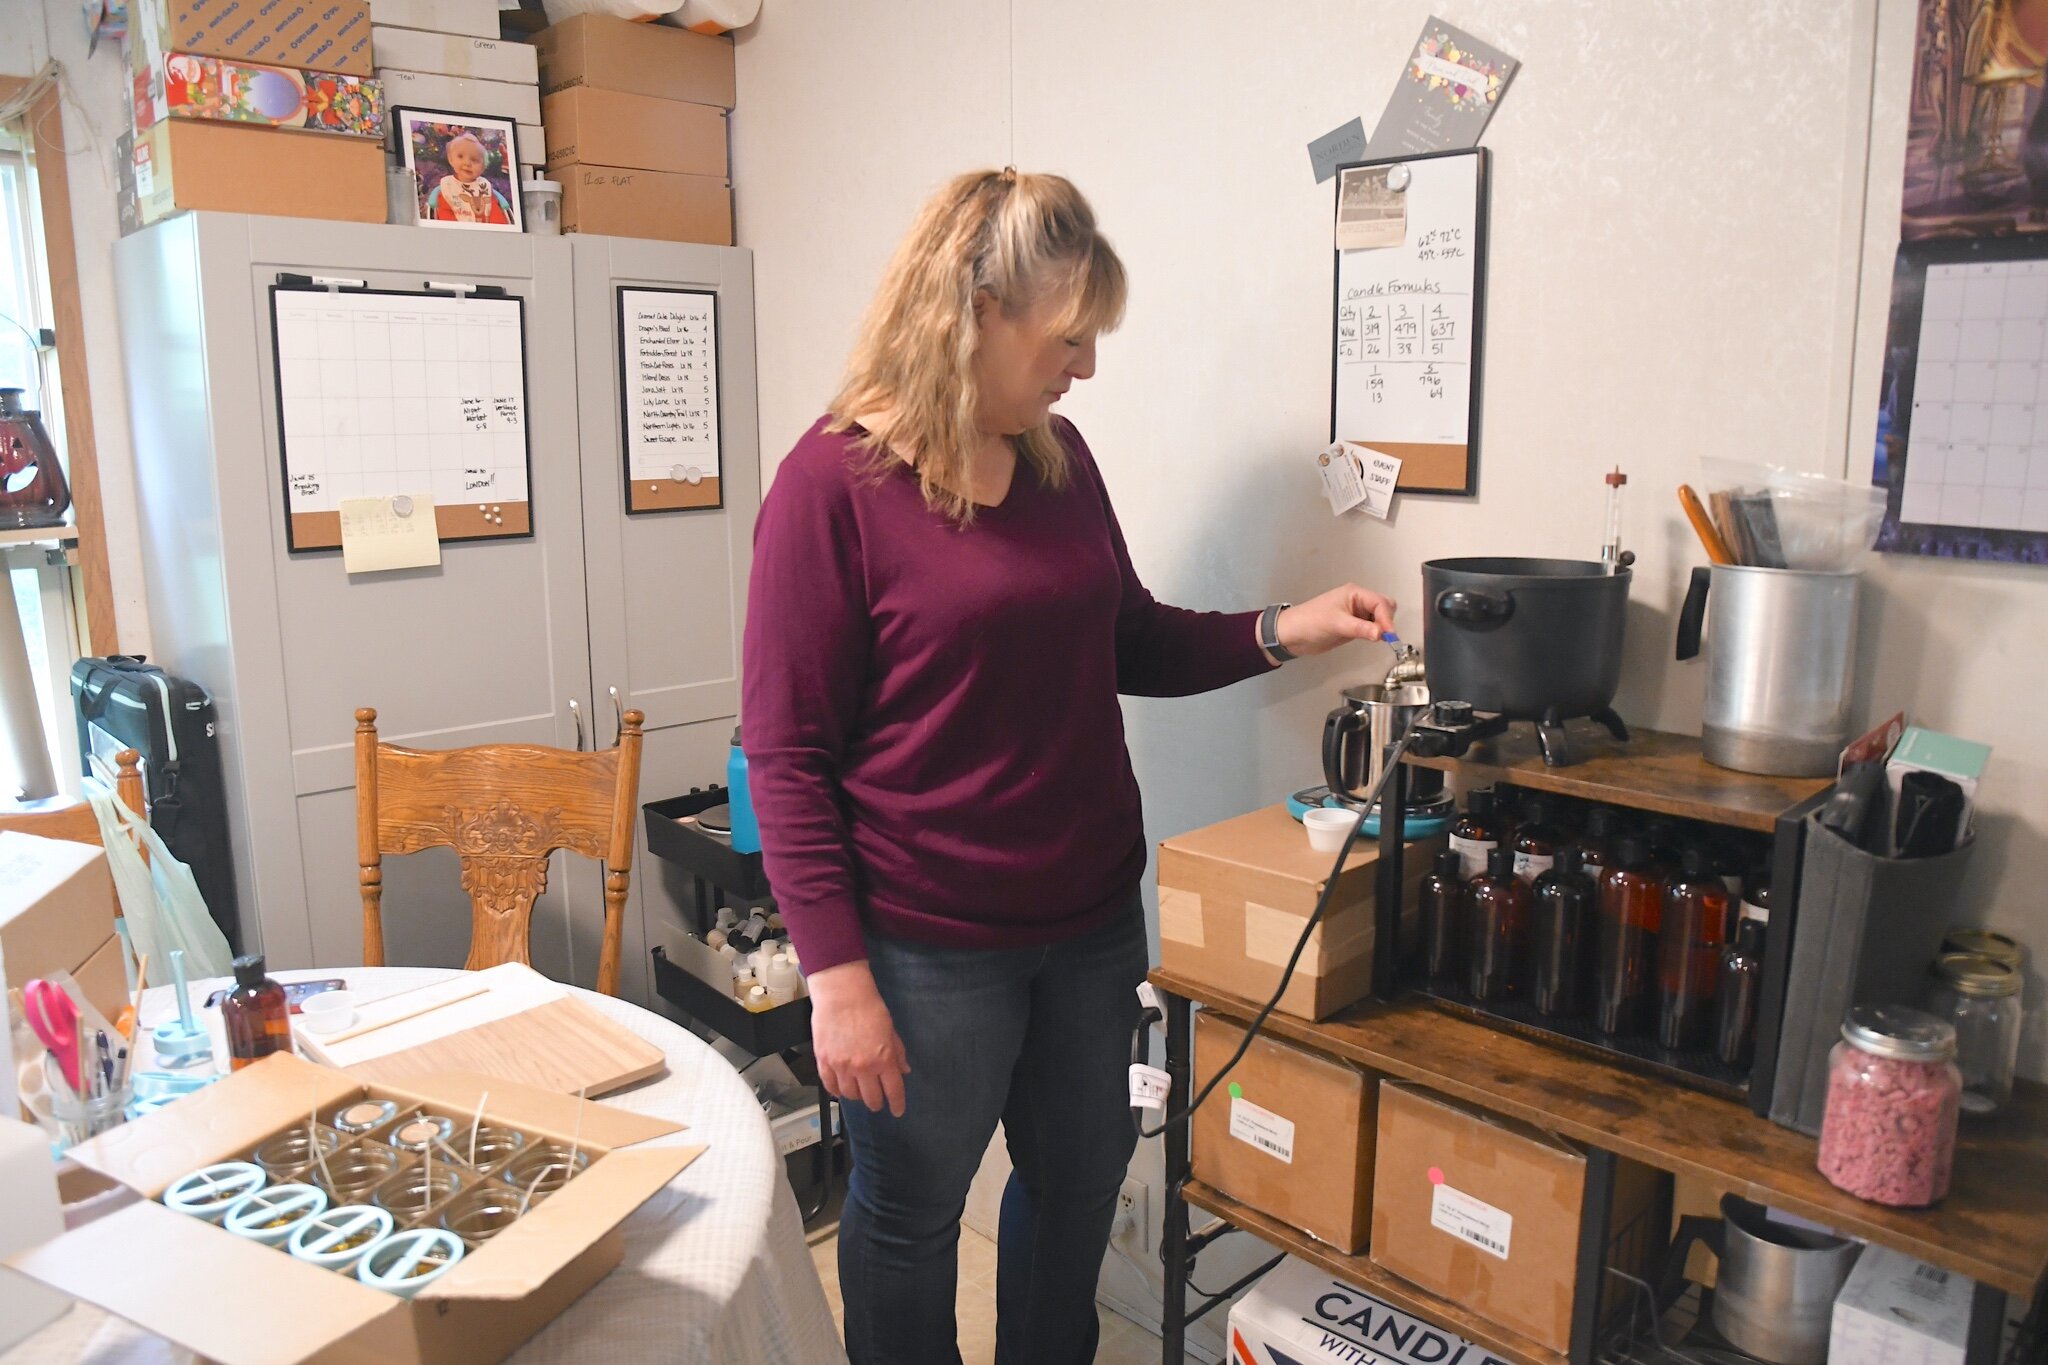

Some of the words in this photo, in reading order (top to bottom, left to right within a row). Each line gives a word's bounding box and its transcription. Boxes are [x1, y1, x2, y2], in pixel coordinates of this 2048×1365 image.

[473, 40, 497, 50] Green
[396, 73, 416, 81] Teal
[610, 175, 634, 186] FLAT
[1387, 277, 1441, 294] Formulas
[1340, 304, 1357, 321] Qty
[1368, 305, 1376, 319] 2
[1399, 304, 1408, 318] 3
[1432, 303, 1442, 318] 4
[1365, 323, 1380, 336] 319
[1394, 322, 1417, 335] 479
[1430, 321, 1456, 337] 637
[1367, 343, 1380, 355] 26
[1397, 343, 1413, 355] 38
[1431, 343, 1444, 355] 51
[1365, 379, 1384, 390] 159
[1419, 376, 1441, 387] 796
[1372, 392, 1383, 404] 13
[1429, 386, 1443, 399] 64
[466, 480, 490, 490] LONDON
[1370, 473, 1392, 486] STAFF
